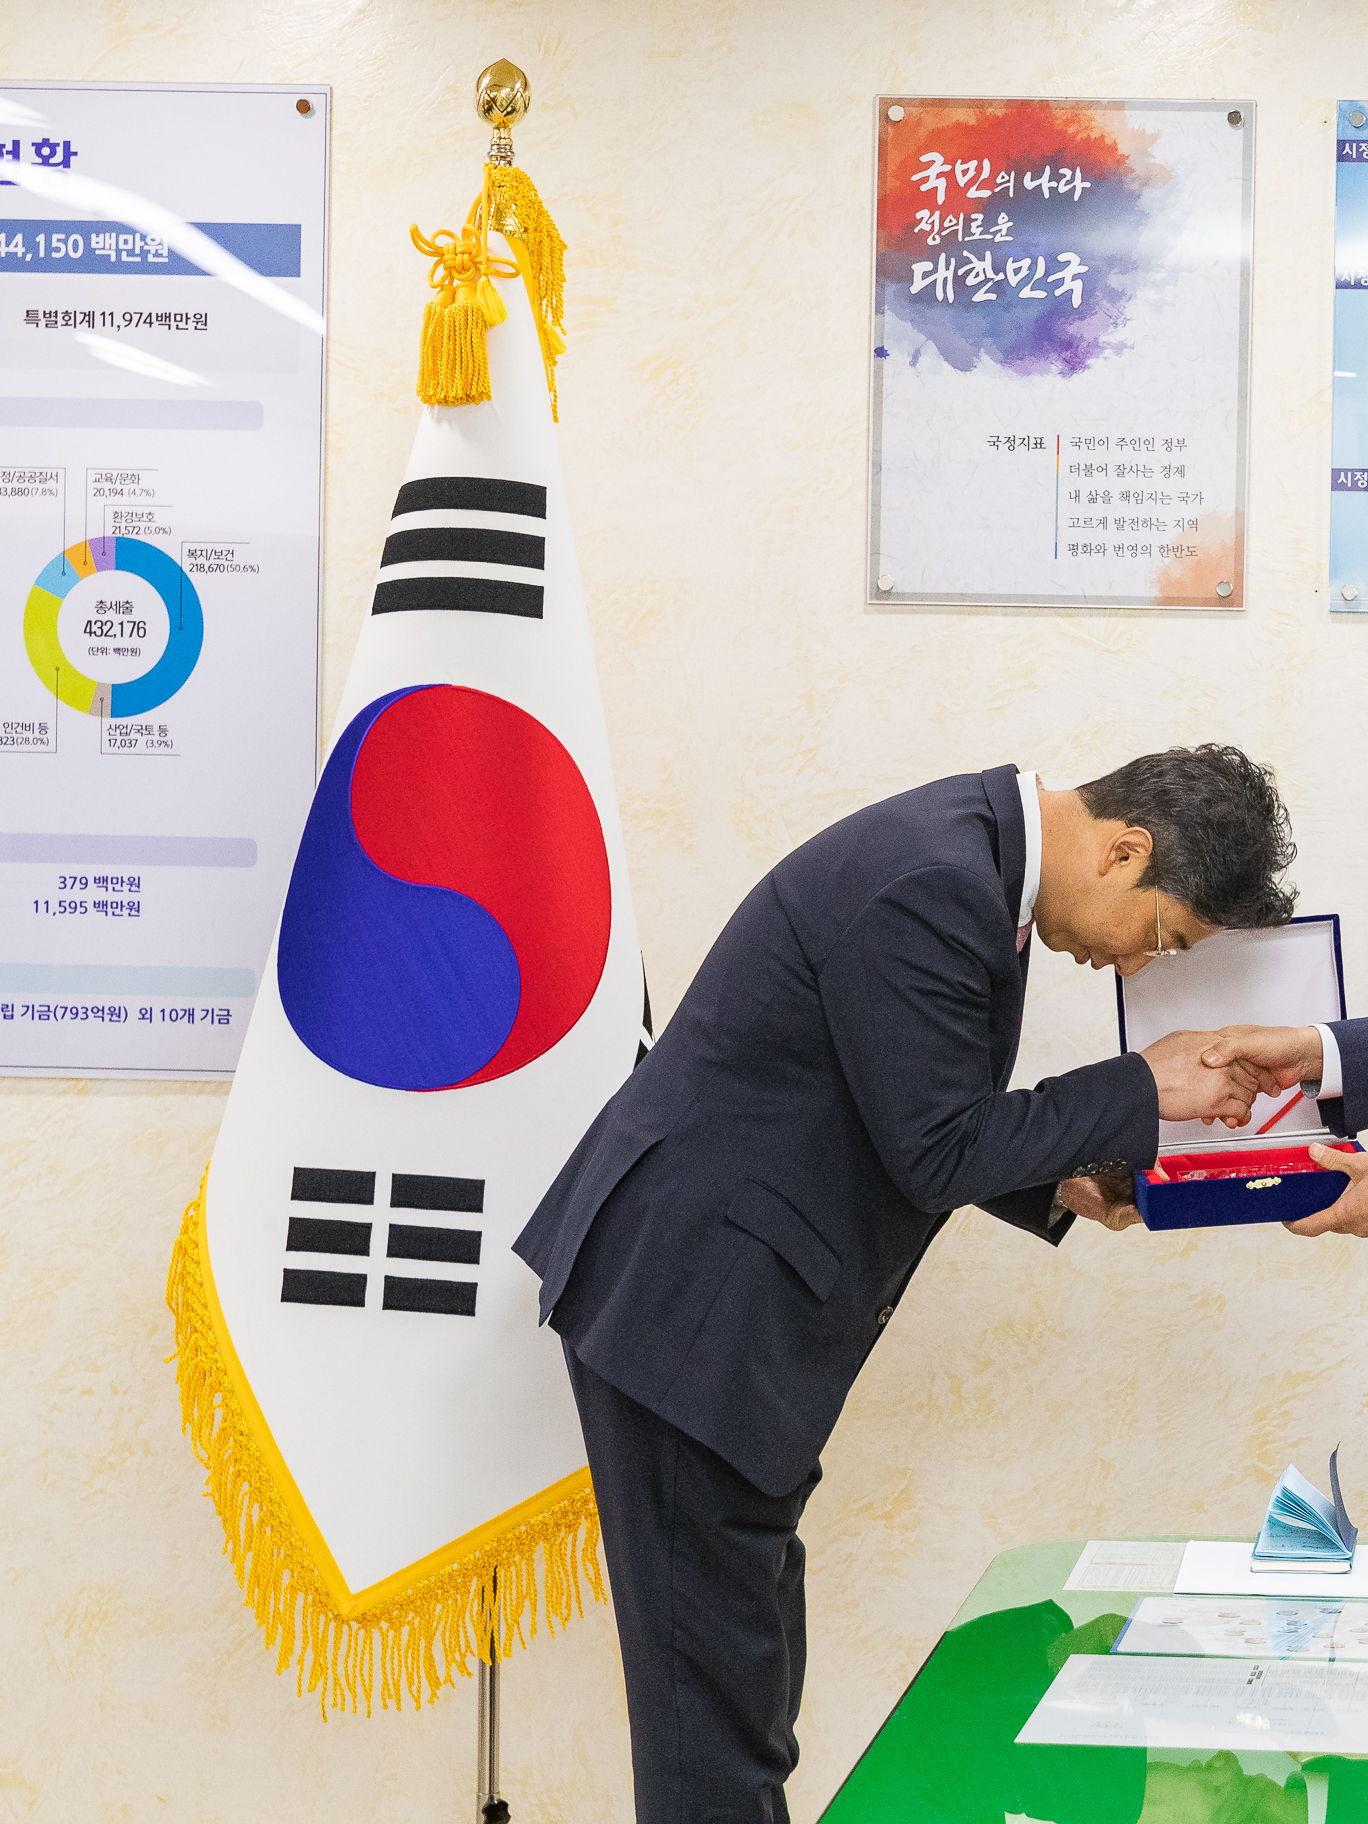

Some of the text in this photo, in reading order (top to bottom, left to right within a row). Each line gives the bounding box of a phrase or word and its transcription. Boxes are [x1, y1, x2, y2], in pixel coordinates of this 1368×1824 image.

[909, 151, 1092, 205] 국민의 나라
[913, 208, 1015, 246] 정의로운
[90, 233, 169, 263] 백만원
[908, 249, 1090, 309] 대한민국
[23, 309, 95, 329] 특별회계
[986, 434, 1047, 451] 국정지표
[1068, 435, 1188, 452] 국민이 주인인 정부
[92, 472, 140, 486] 교육/문화
[1068, 462, 1186, 479] 더불어 잘사는 경제
[92, 487, 155, 498] 20,194 (4.7%)
[1067, 488, 1204, 505] 내 삶을 책임지는 국가
[111, 510, 156, 523] 환경보호
[1067, 515, 1198, 533] 고르게 발전하는 지역
[111, 525, 172, 537] 21,572 (5.0%)
[186, 547, 235, 562] 복지/보건
[1066, 542, 1198, 558] 평화와 번영의 한반도
[93, 599, 134, 615] 총세출
[82, 619, 146, 639] 432,176
[2, 721, 48, 735] 인건비 등
[106, 722, 169, 736] 산업/국토 등
[107, 737, 173, 749] 17,037 (3.9%)
[57, 874, 141, 893] 379 백만원
[32, 899, 141, 917] 11,595 백만원
[19, 1004, 128, 1023] 기금(793억원)
[136, 1006, 153, 1023] 외
[159, 1007, 195, 1024] 10개
[199, 1007, 232, 1024] 기금
